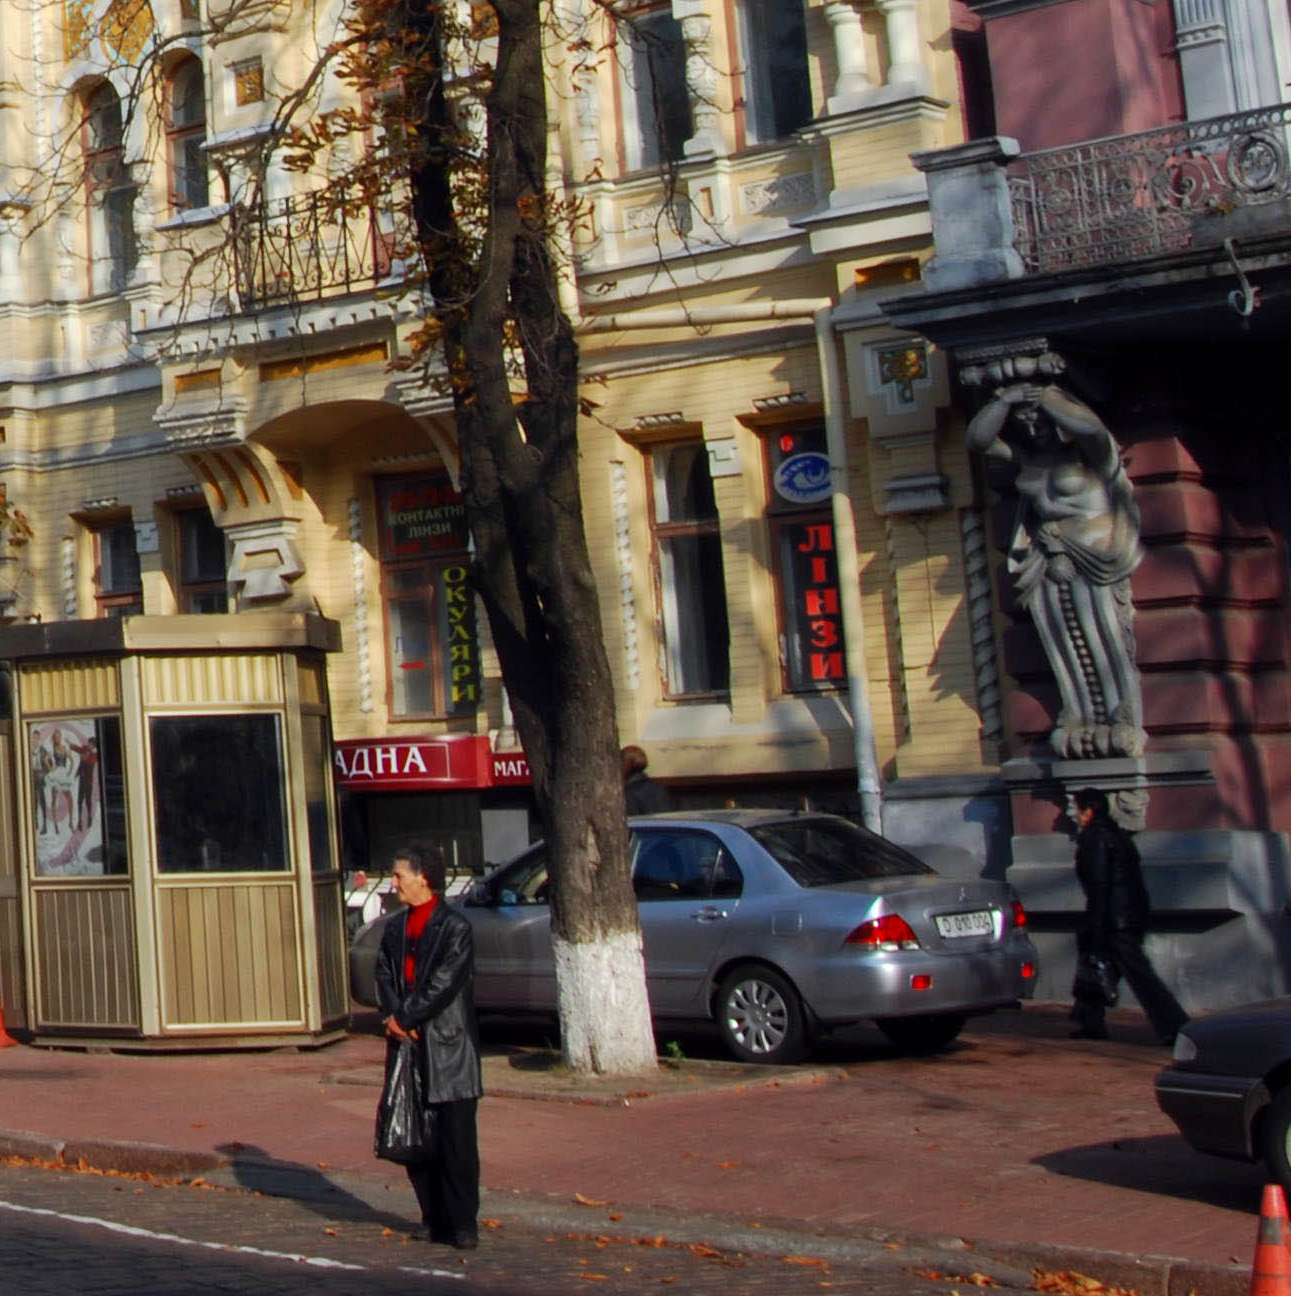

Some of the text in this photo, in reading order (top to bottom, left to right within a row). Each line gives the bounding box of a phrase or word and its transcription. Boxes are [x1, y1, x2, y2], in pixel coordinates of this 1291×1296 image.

[387, 503, 465, 525] КОНТАКТНІ
[409, 522, 452, 539] ЛІНЗИ
[798, 524, 845, 680] ЛІНЗИ
[442, 566, 476, 704] ОКУЛЯРИ
[335, 746, 428, 779] АДНА
